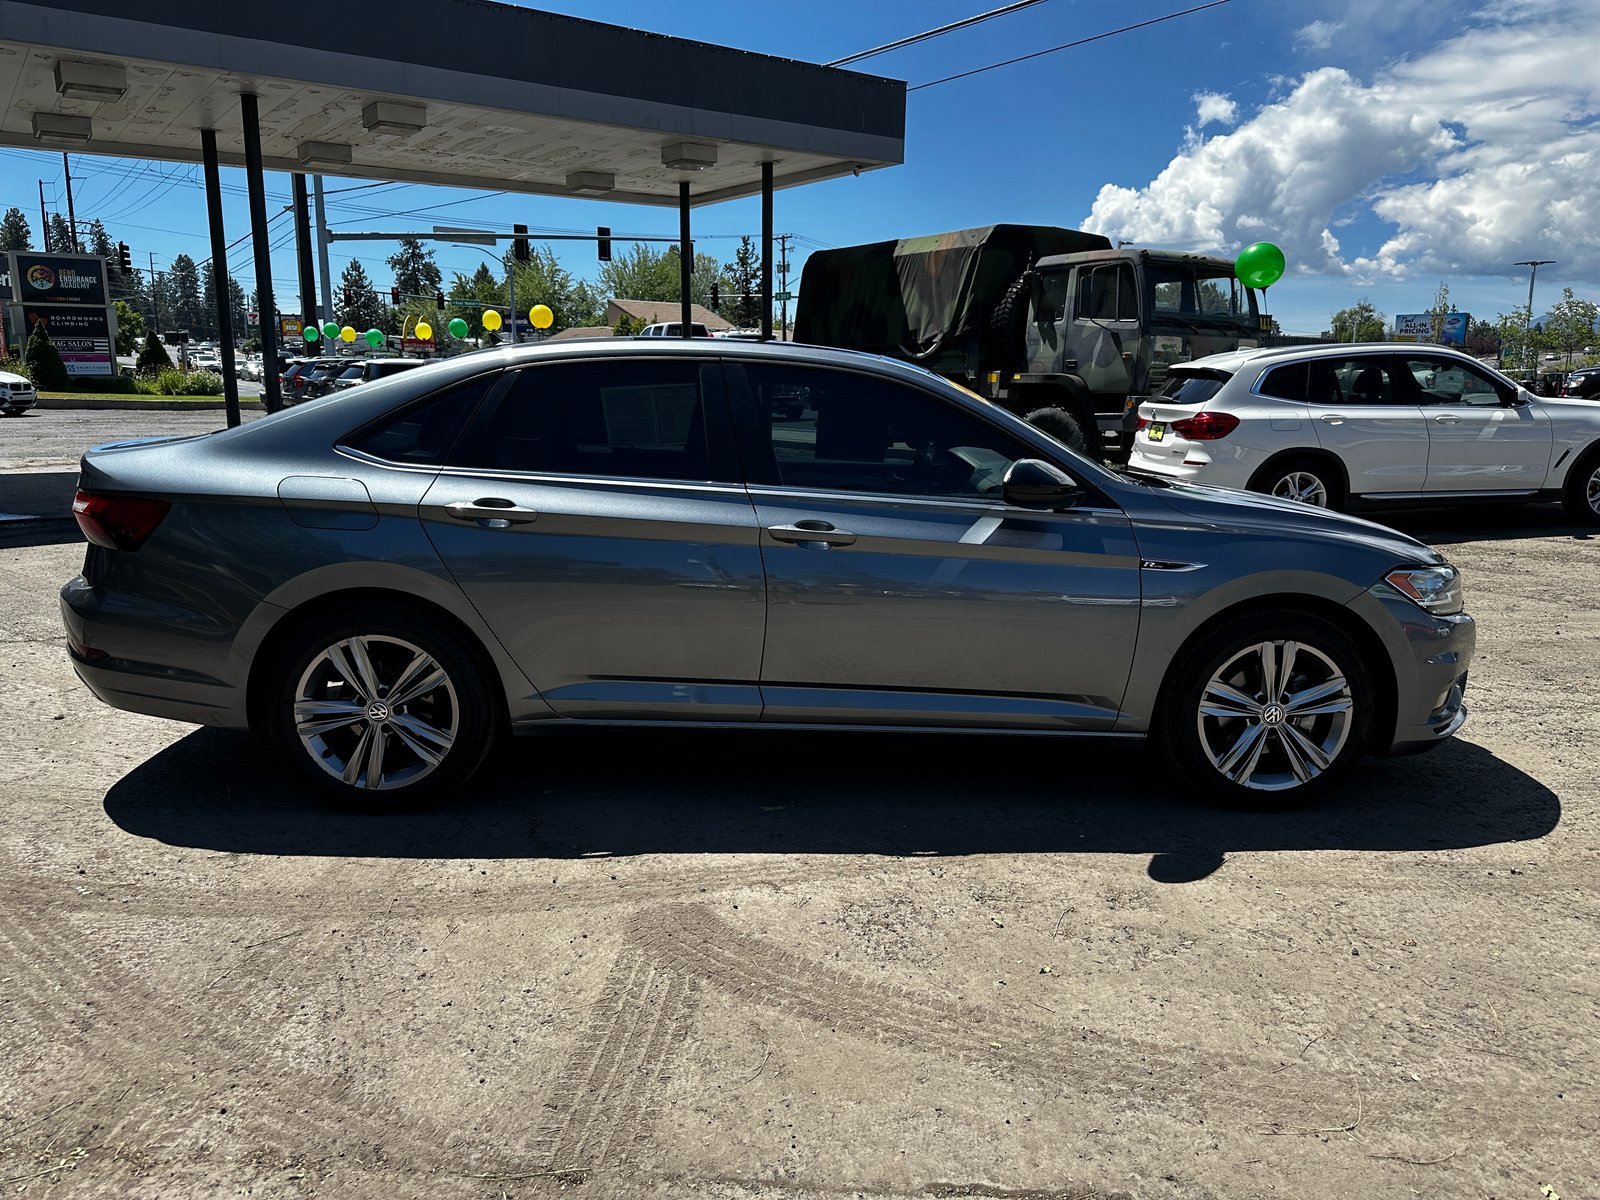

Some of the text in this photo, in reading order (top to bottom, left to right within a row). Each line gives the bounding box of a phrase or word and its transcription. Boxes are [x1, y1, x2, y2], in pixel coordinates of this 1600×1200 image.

[58, 269, 76, 277] BEND
[59, 275, 97, 284] ENDURANCE
[60, 281, 90, 289] ACADEMY
[67, 340, 93, 348] SALON
